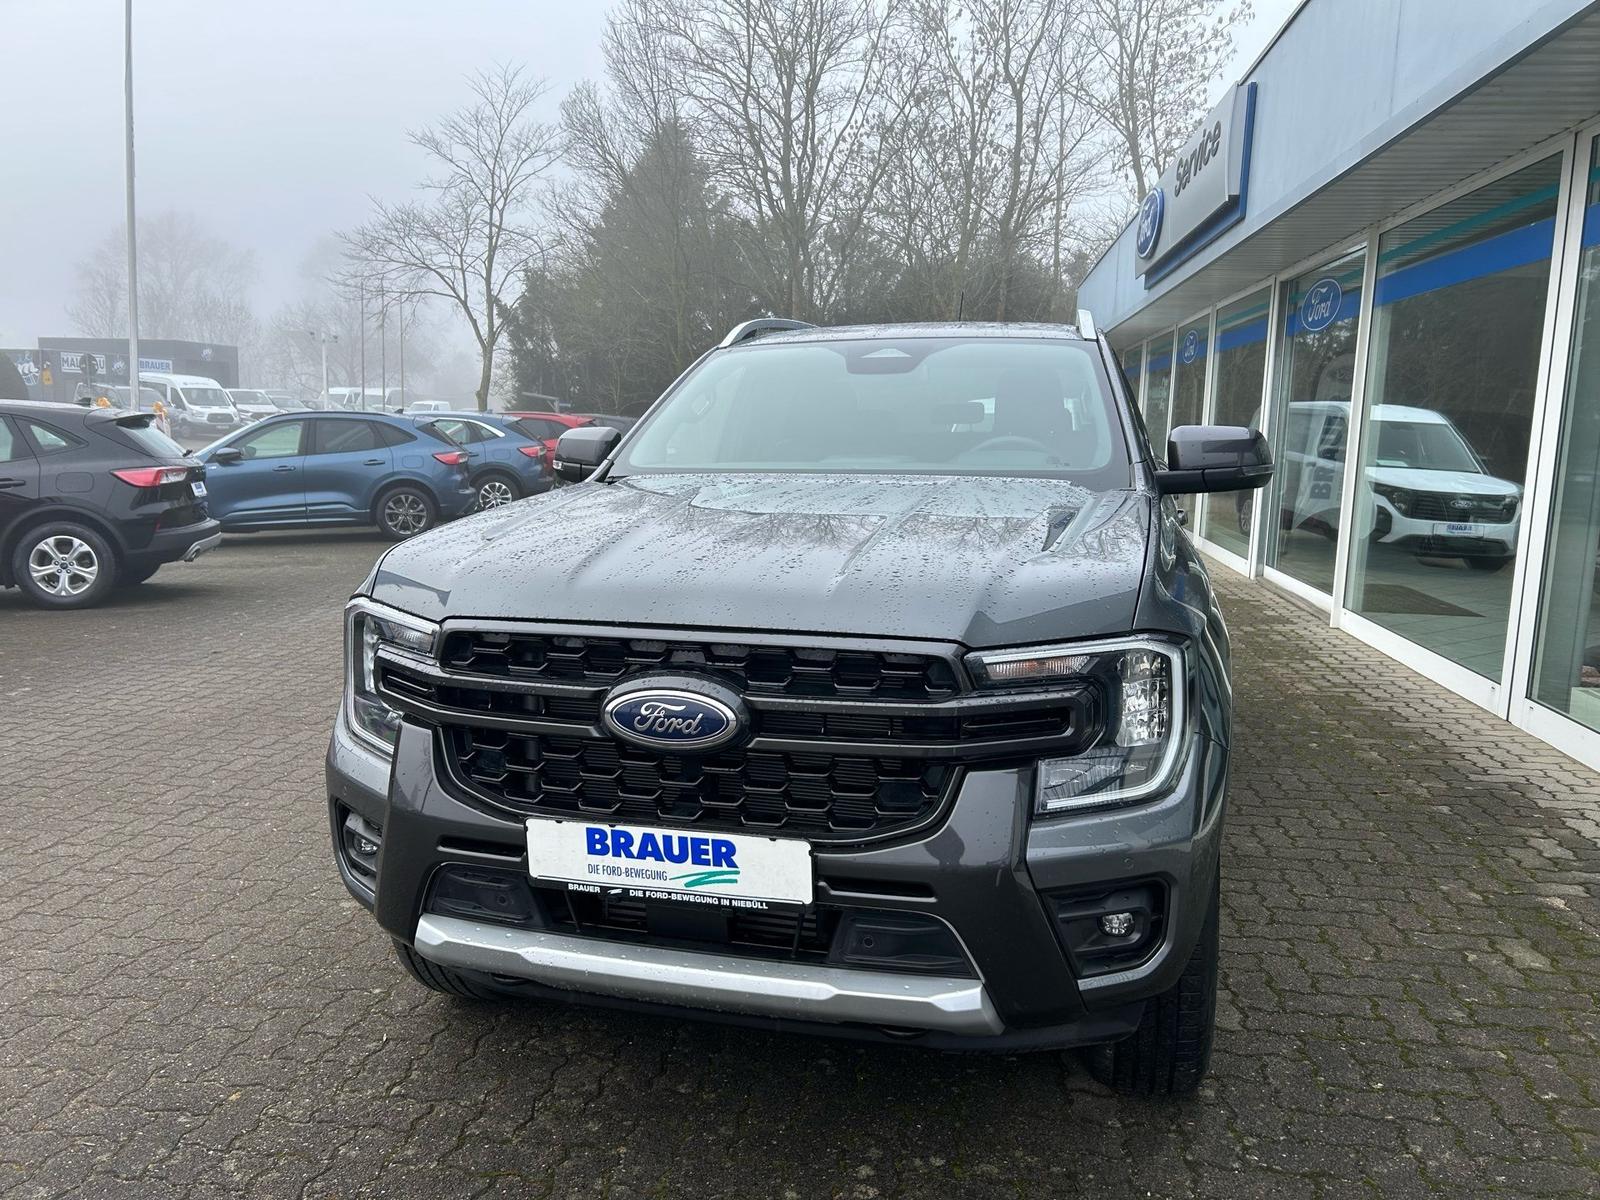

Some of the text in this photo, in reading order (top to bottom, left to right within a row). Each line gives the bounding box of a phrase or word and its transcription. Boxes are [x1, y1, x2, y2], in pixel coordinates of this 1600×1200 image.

[1174, 120, 1221, 197] Service
[1308, 287, 1333, 321] Ford
[139, 360, 171, 370] BRAUER
[634, 701, 703, 735] Ford
[585, 827, 739, 869] BRAUER
[587, 864, 668, 881] DIE FORD-BEWEGUNG
[568, 883, 769, 910] BRAUER DIE FORD-BEWEGUNG IN NIEBÜLL
